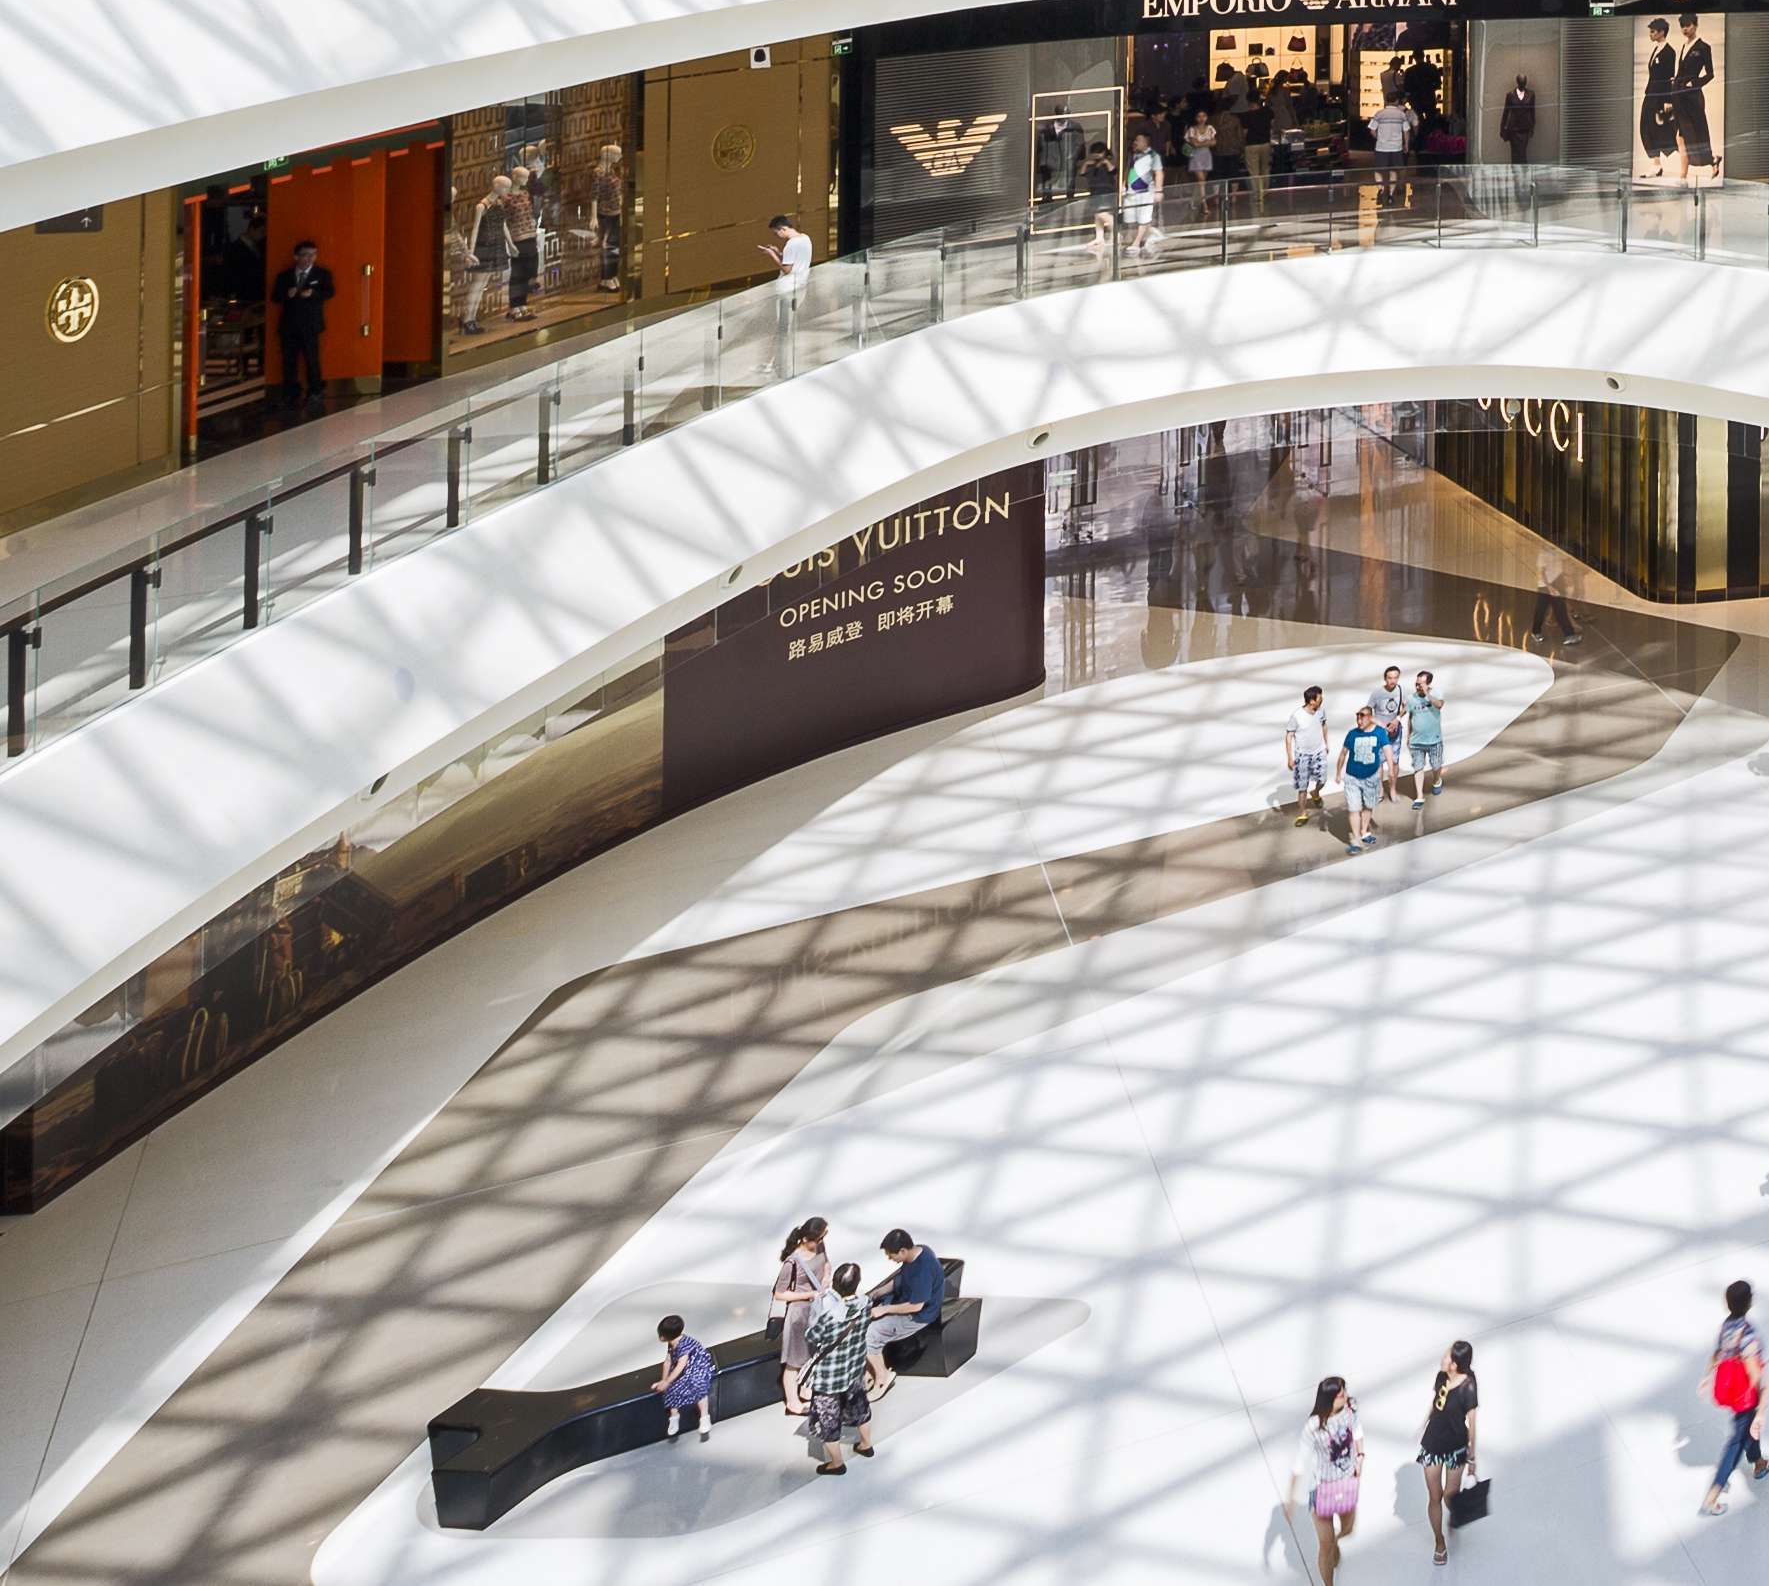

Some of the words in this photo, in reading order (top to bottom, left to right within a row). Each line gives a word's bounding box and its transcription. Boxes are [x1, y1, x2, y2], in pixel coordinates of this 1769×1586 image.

[779, 581, 885, 628] OPENING
[893, 559, 965, 594] SOON
[787, 620, 864, 661] 路易威登
[877, 594, 955, 632] 即将开幕
